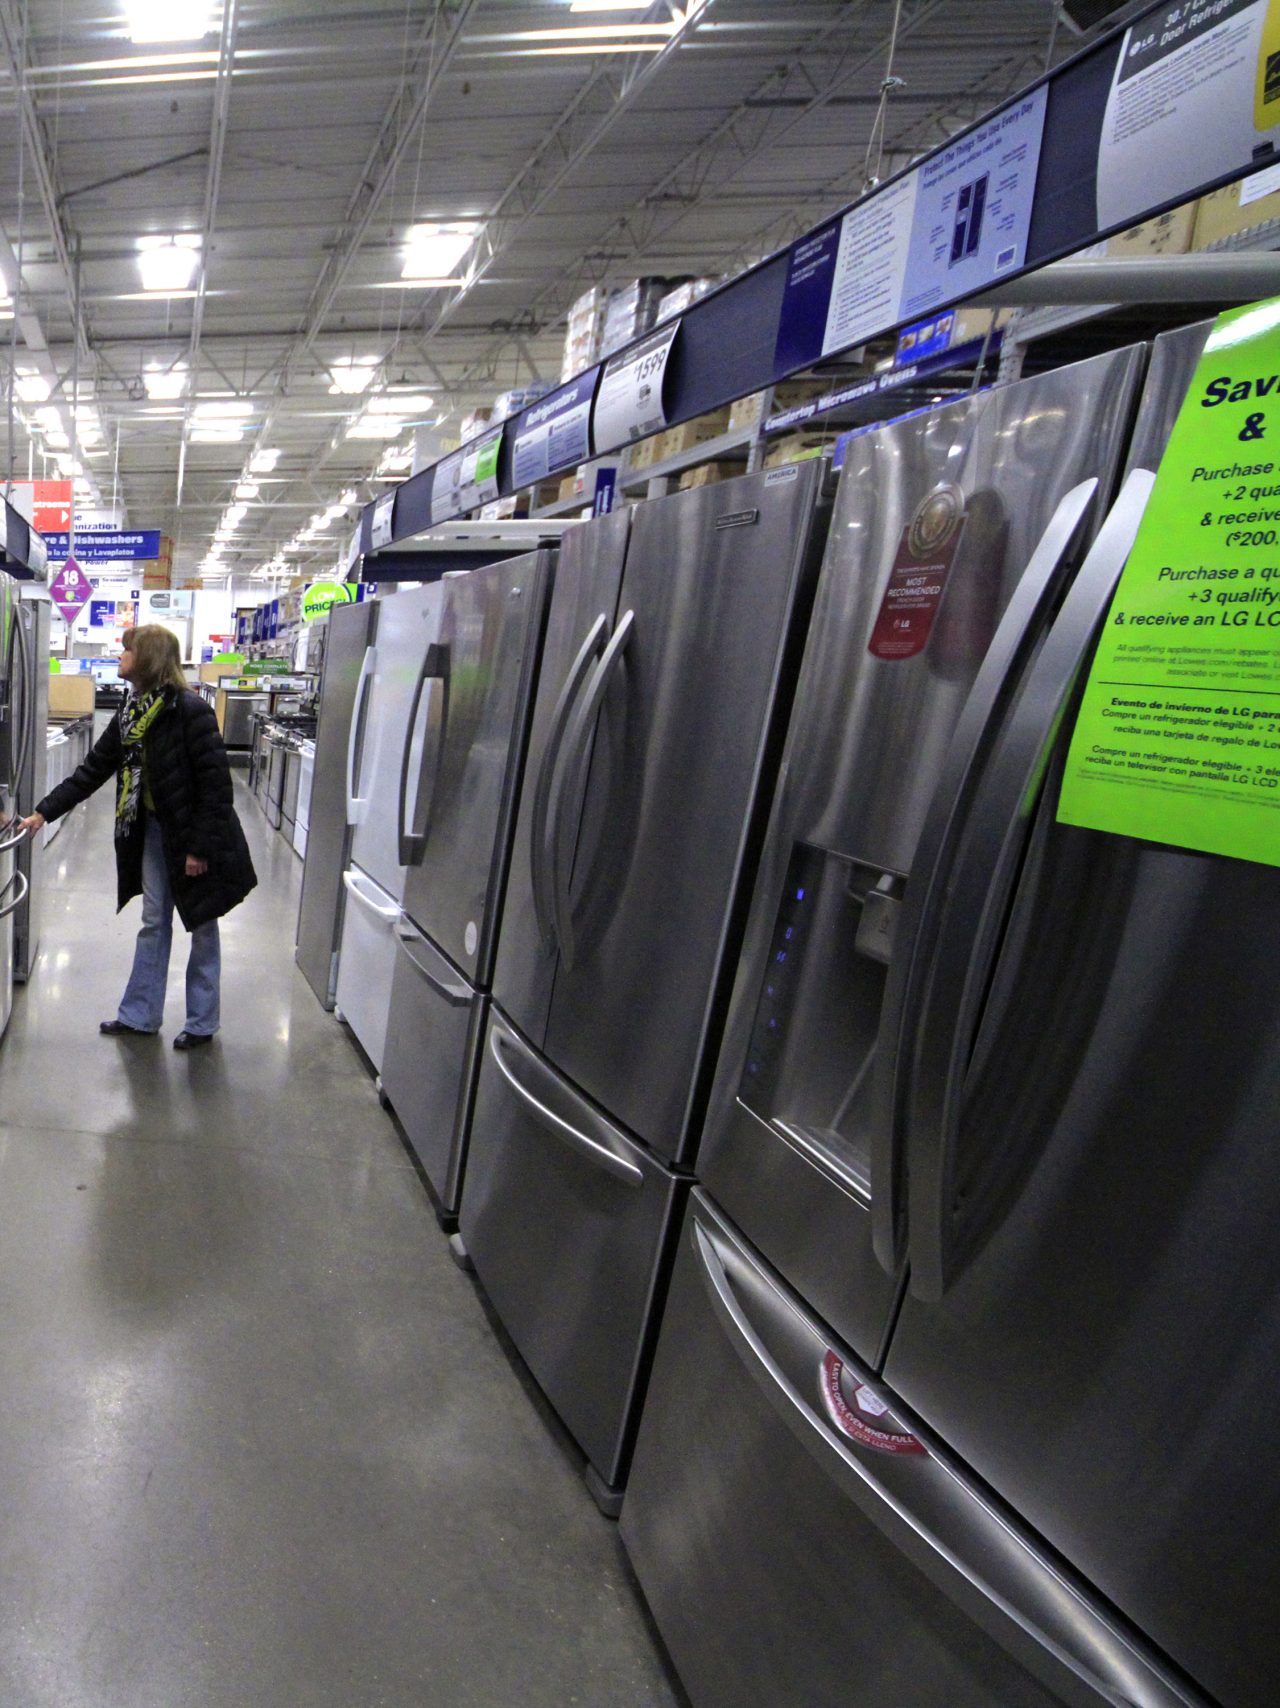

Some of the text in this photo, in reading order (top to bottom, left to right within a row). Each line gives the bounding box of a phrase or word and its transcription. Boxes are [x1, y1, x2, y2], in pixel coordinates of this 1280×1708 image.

[1160, 23, 1186, 46] Door
[765, 365, 918, 431] Countertop Microwave Ovens
[1238, 412, 1267, 441] &
[1191, 463, 1274, 482] Purchase
[1200, 508, 1280, 526] & receive
[59, 536, 67, 544] &
[93, 548, 135, 557] Lavaplatos
[62, 570, 79, 586] 18
[906, 577, 928, 587] MOST
[1158, 566, 1239, 581] Purchase
[1243, 568, 1255, 579] a
[312, 590, 336, 602] LOW
[888, 586, 941, 597] RECOMMENDED
[1216, 587, 1280, 606] qualify
[1114, 612, 1124, 625] &
[1129, 612, 1190, 626] receive
[1193, 615, 1216, 626] an
[1221, 610, 1249, 627] LG
[1111, 697, 1147, 709] Evento
[1149, 700, 1163, 710] de
[1165, 701, 1212, 714] invierno
[1214, 706, 1230, 716] de
[1232, 706, 1251, 717] LG
[1102, 708, 1137, 720] Compre
[1139, 713, 1151, 721] un
[1153, 713, 1212, 727] refrigerador
[1213, 720, 1254, 731] elegible
[1267, 724, 1275, 732] 2
[1113, 725, 1141, 735] reciba
[1143, 728, 1161, 736] una
[1163, 730, 1194, 741] tarjeta
[1196, 732, 1209, 742] de
[1211, 735, 1245, 747] regalo
[1247, 737, 1261, 748] de
[1092, 745, 1127, 758] Compre
[1129, 750, 1141, 758] un
[1143, 751, 1200, 766] refrigerador
[1202, 759, 1242, 772] elegible
[1255, 765, 1263, 774] 3
[1085, 755, 1278, 789] reciba un televisor con pantalla LG LCD
[832, 1362, 841, 1381] EASY
[832, 1381, 839, 1391] TO
[846, 1412, 864, 1429] EVEN
[864, 1427, 891, 1441] WHEN
[891, 1435, 915, 1443] FULL
